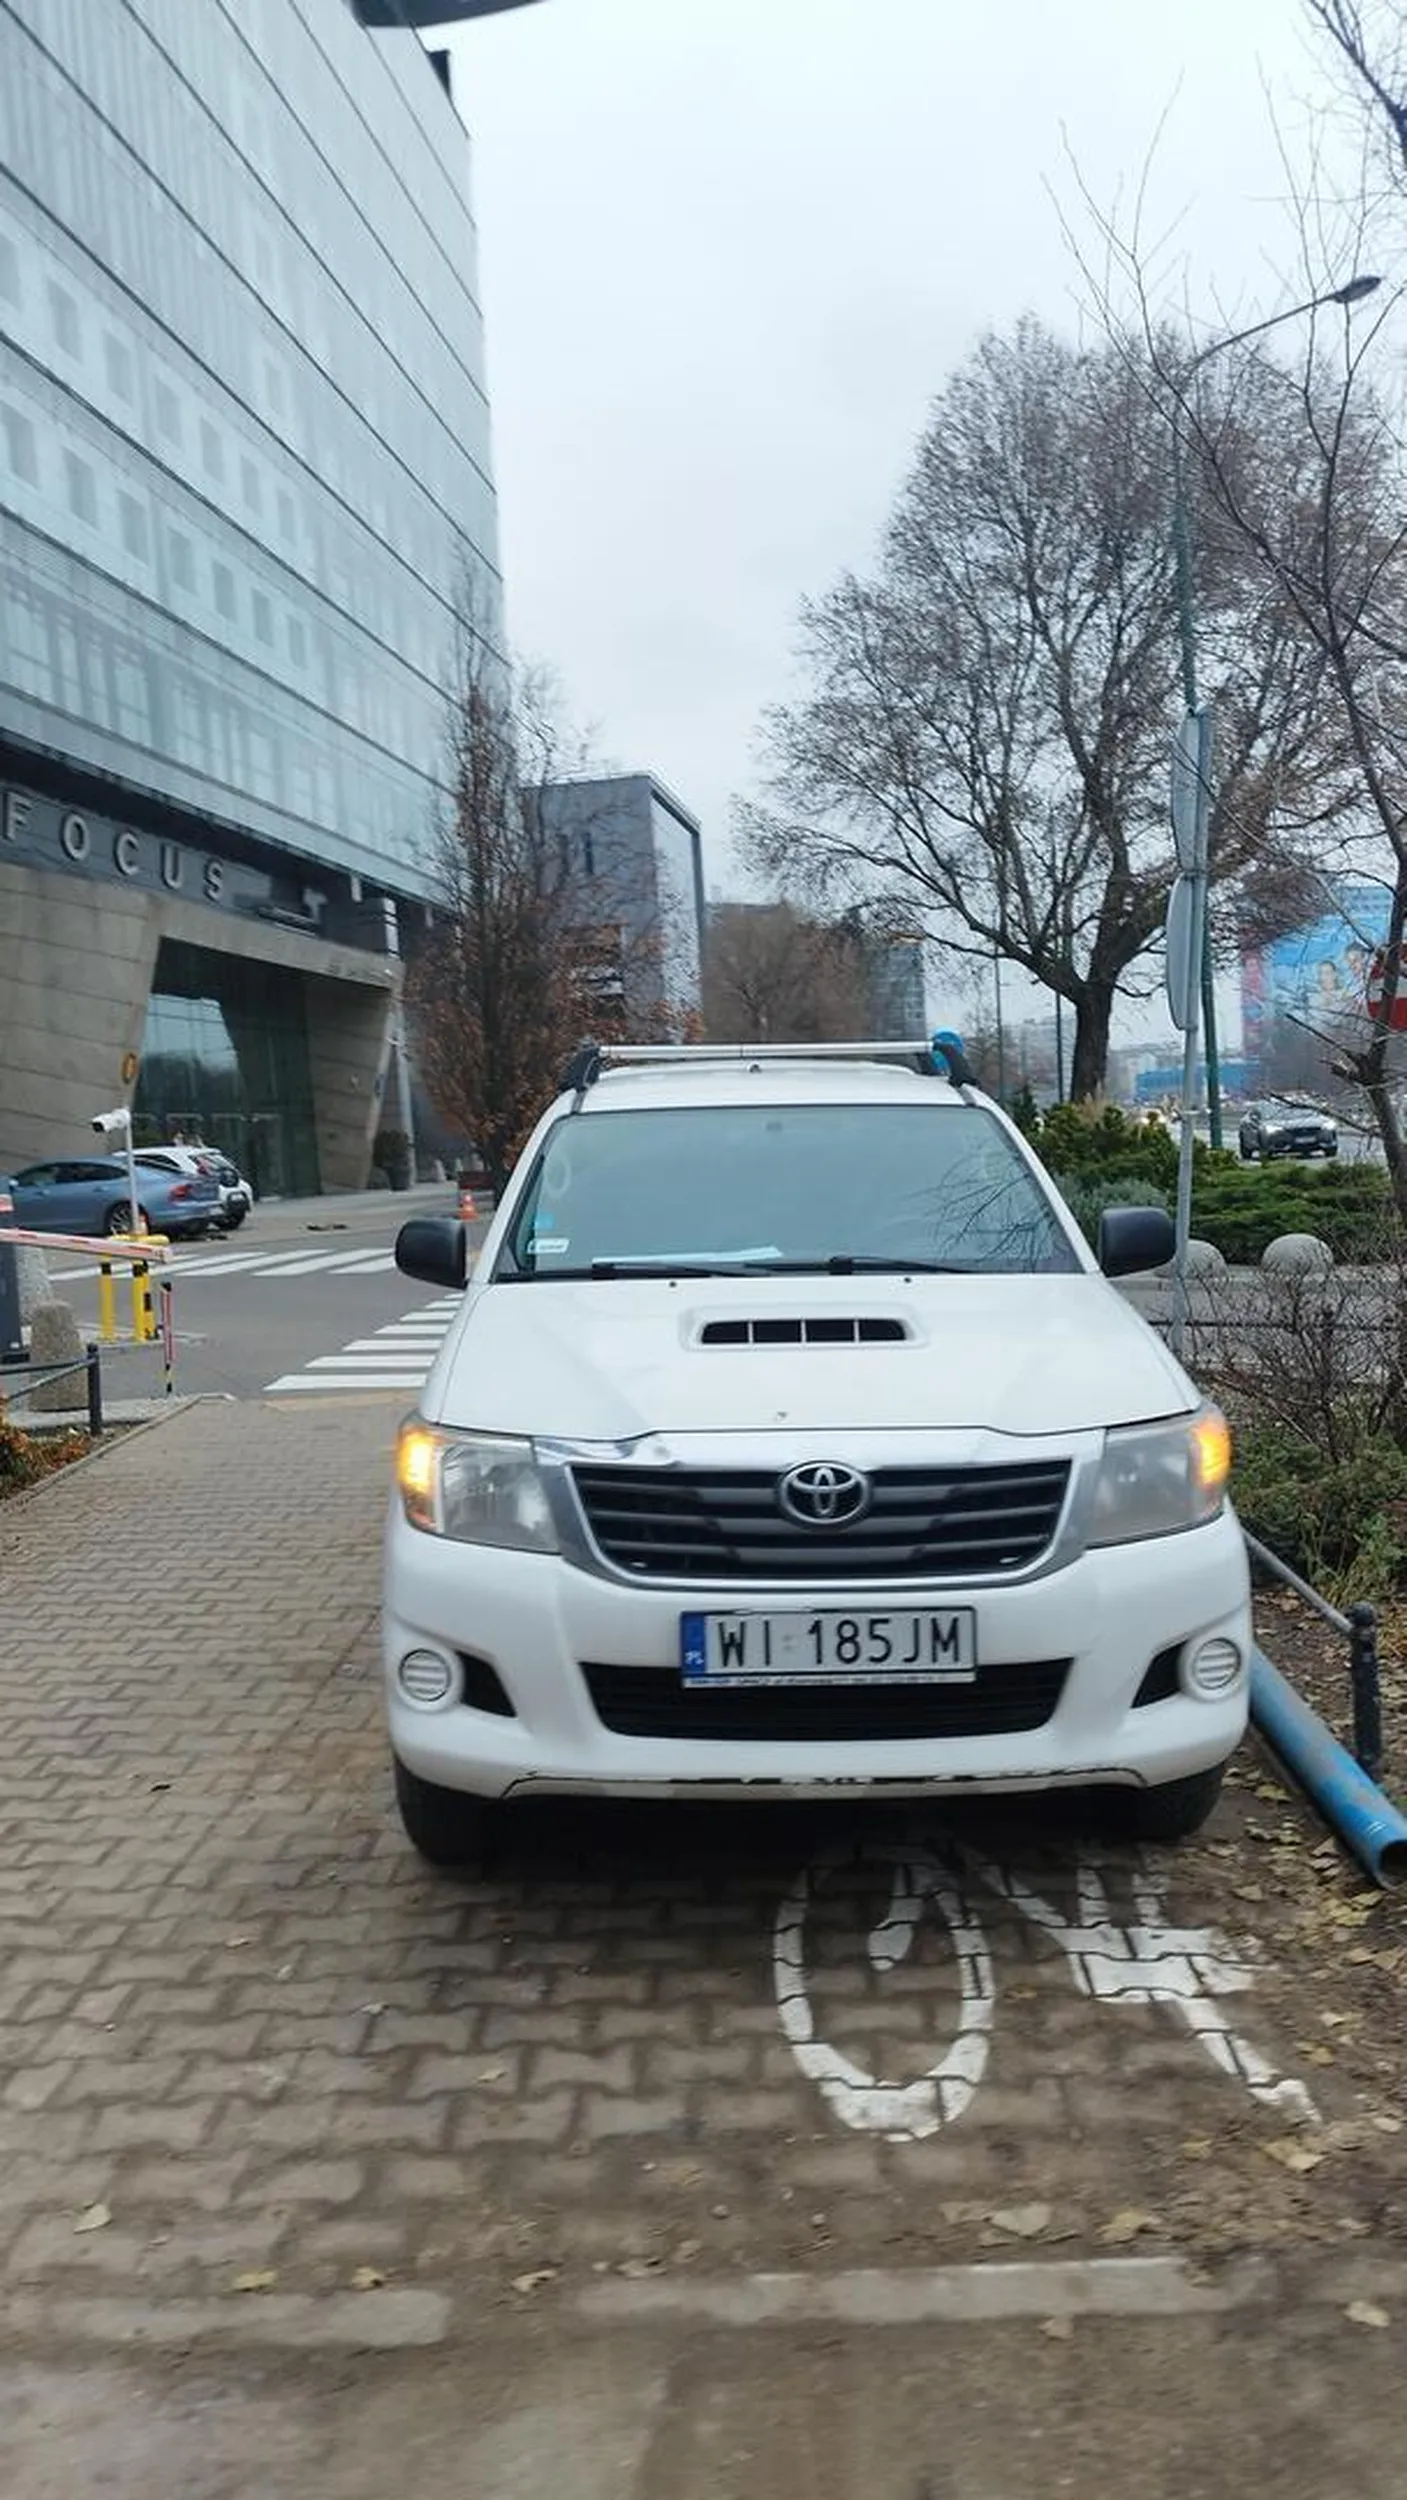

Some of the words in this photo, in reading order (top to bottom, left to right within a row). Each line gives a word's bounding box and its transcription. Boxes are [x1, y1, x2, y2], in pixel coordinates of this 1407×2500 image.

[2, 789, 225, 902] FOCUS
[717, 1619, 772, 1667] WI
[807, 1616, 960, 1665] 185JM
